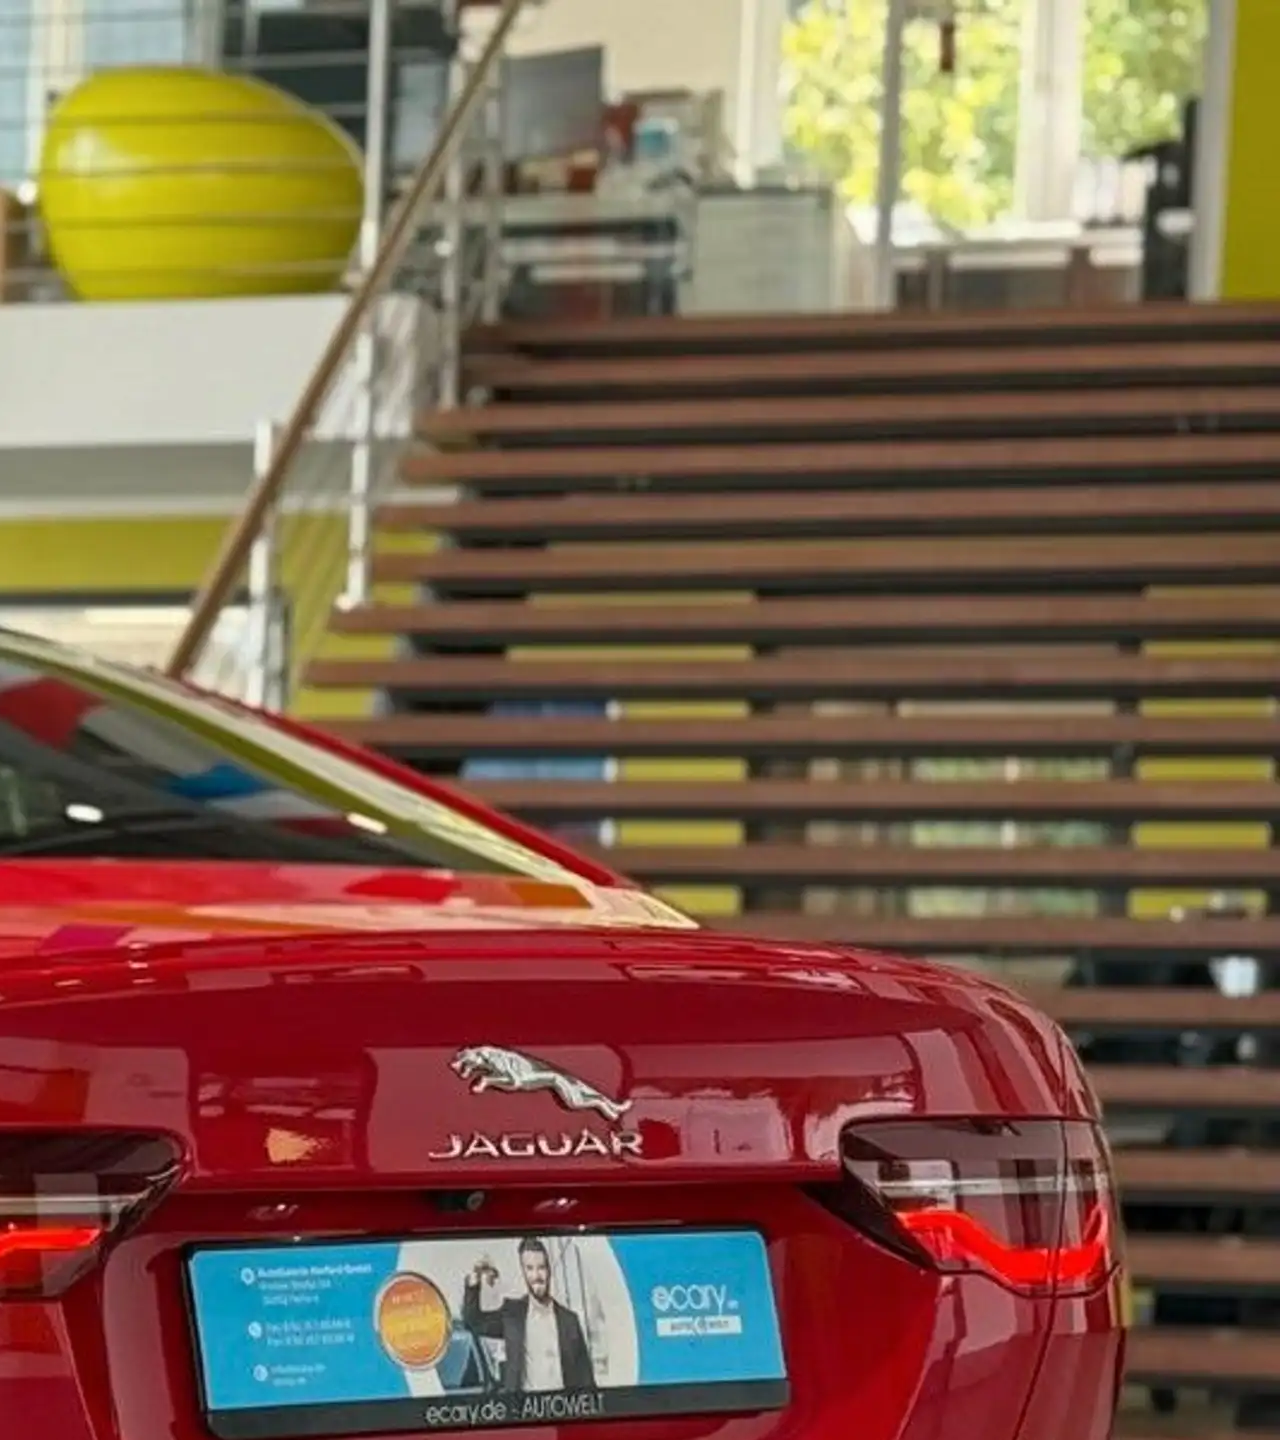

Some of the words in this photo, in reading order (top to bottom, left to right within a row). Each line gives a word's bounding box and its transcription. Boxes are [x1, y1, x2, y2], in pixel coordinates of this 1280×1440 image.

[428, 1128, 644, 1160] JAGUAR
[425, 1399, 507, 1426] ecary.de
[521, 1393, 605, 1419] AUTOWELT
